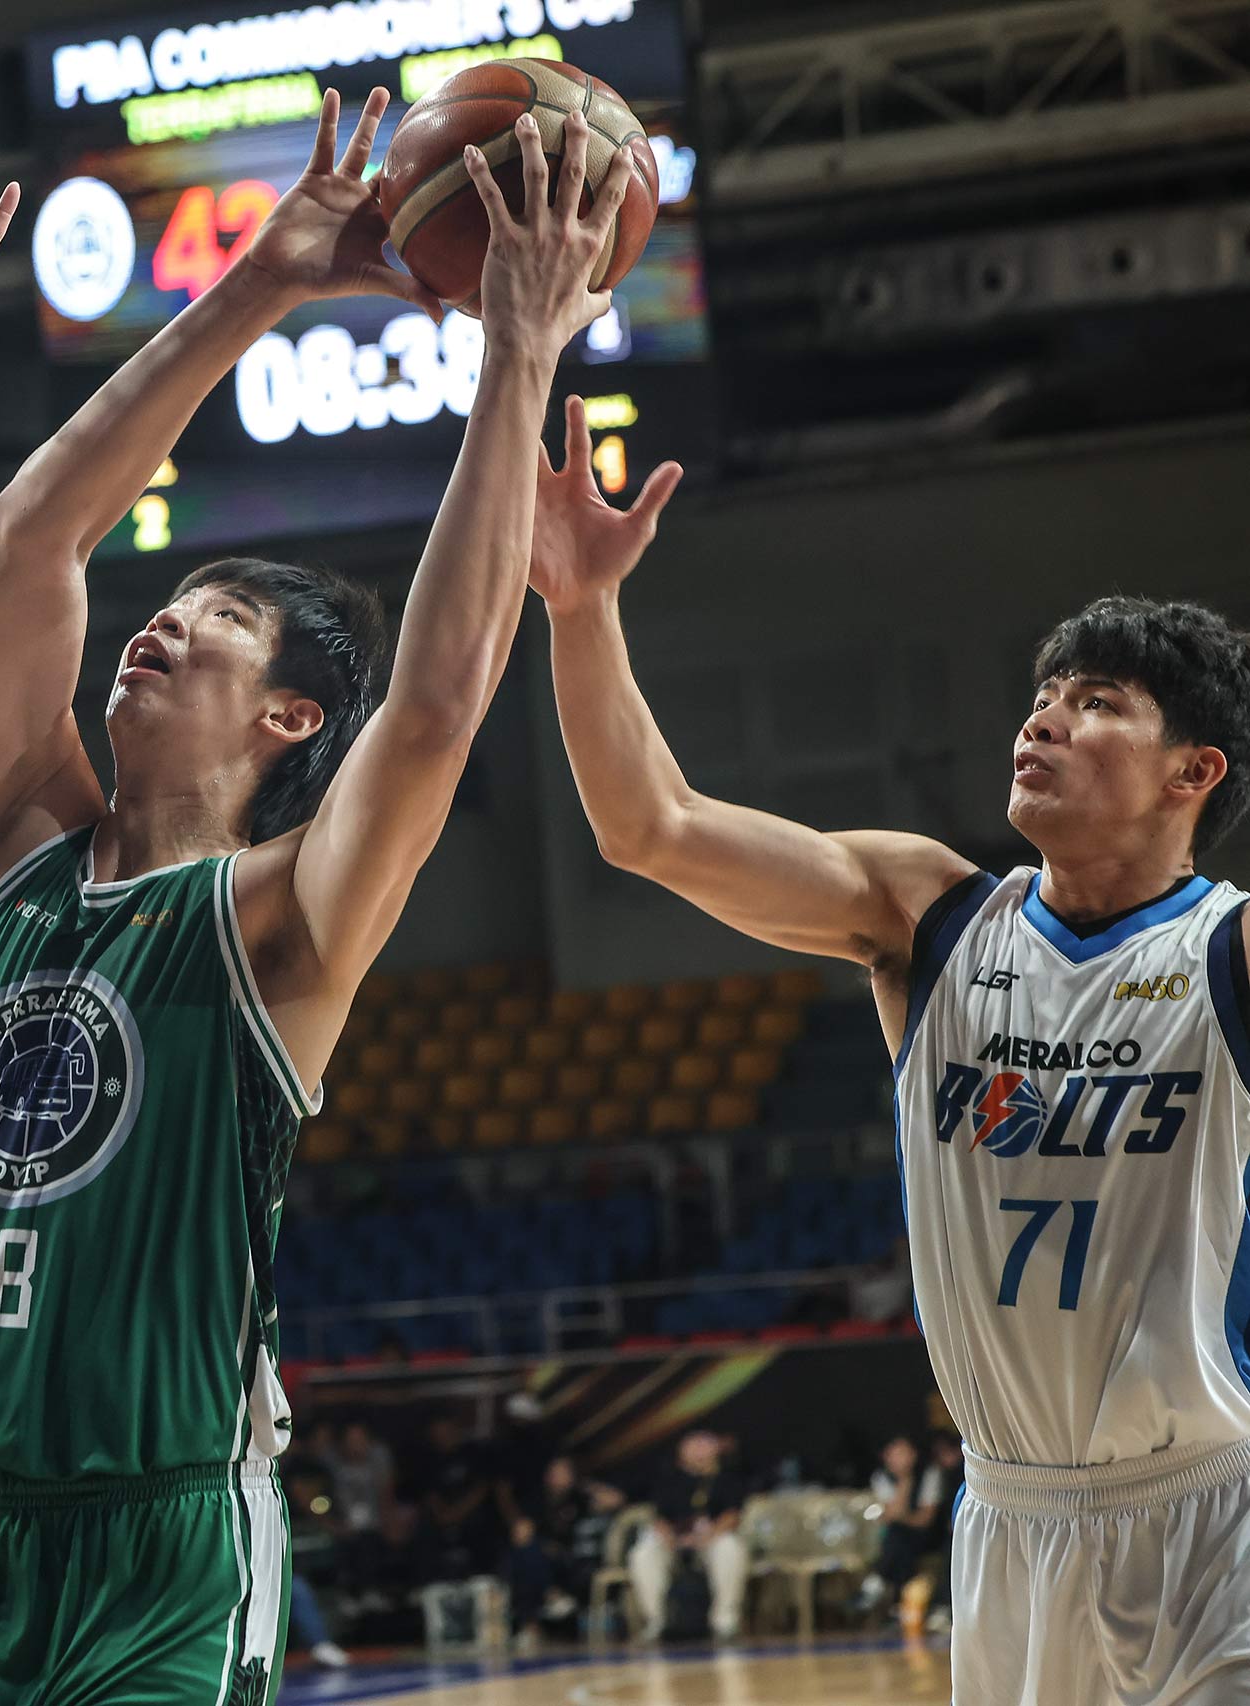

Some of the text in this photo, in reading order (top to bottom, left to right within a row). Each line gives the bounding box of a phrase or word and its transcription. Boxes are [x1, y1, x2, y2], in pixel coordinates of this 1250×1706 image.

[977, 1032, 1142, 1072] MERALCO
[935, 1061, 1203, 1159] BOLTS
[996, 1198, 1099, 1312] 71
